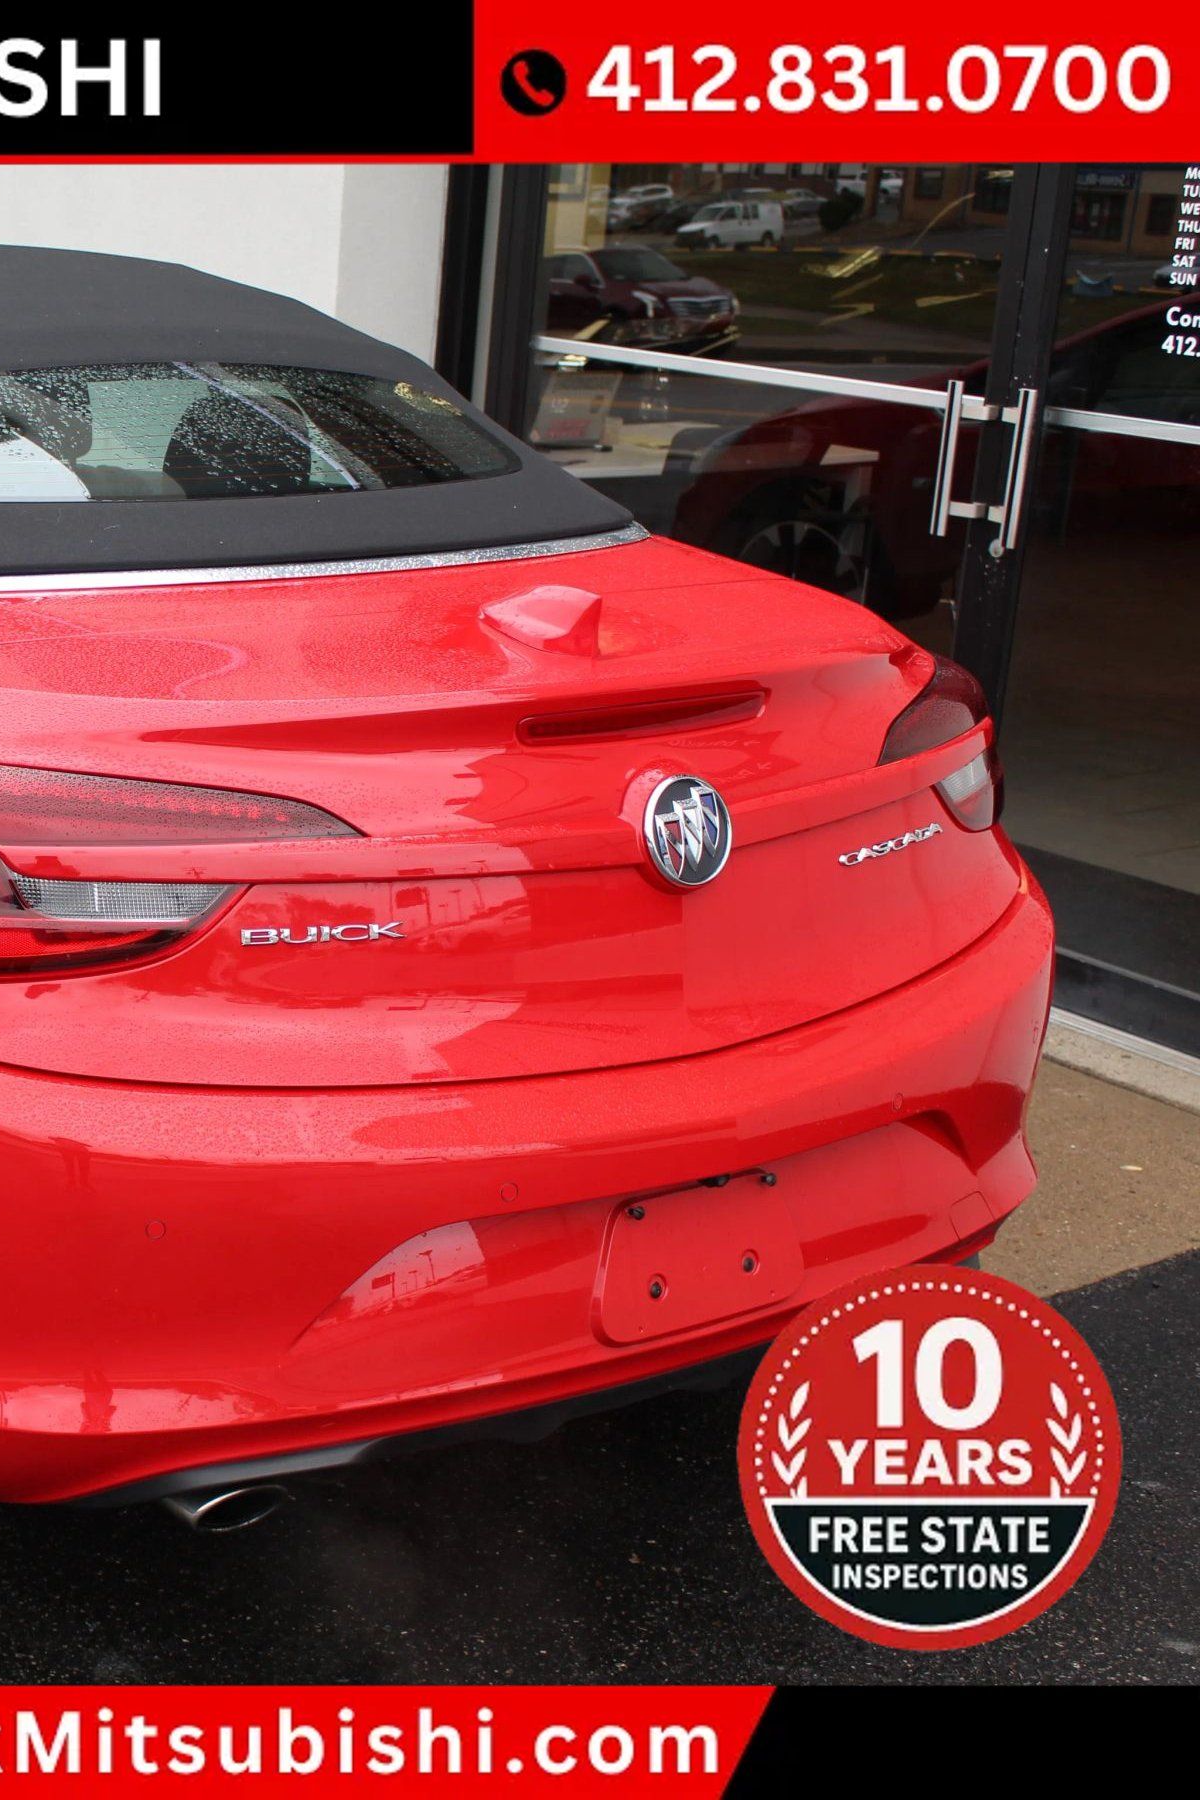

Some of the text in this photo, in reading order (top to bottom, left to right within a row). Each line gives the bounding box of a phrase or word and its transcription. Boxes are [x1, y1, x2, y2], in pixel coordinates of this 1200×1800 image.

[1184, 166, 1200, 180] M
[1174, 236, 1195, 251] FRI
[1171, 254, 1196, 268] SAT
[1169, 271, 1198, 286] SUN
[838, 822, 943, 866] CASCADA
[240, 920, 407, 947] BUICK
